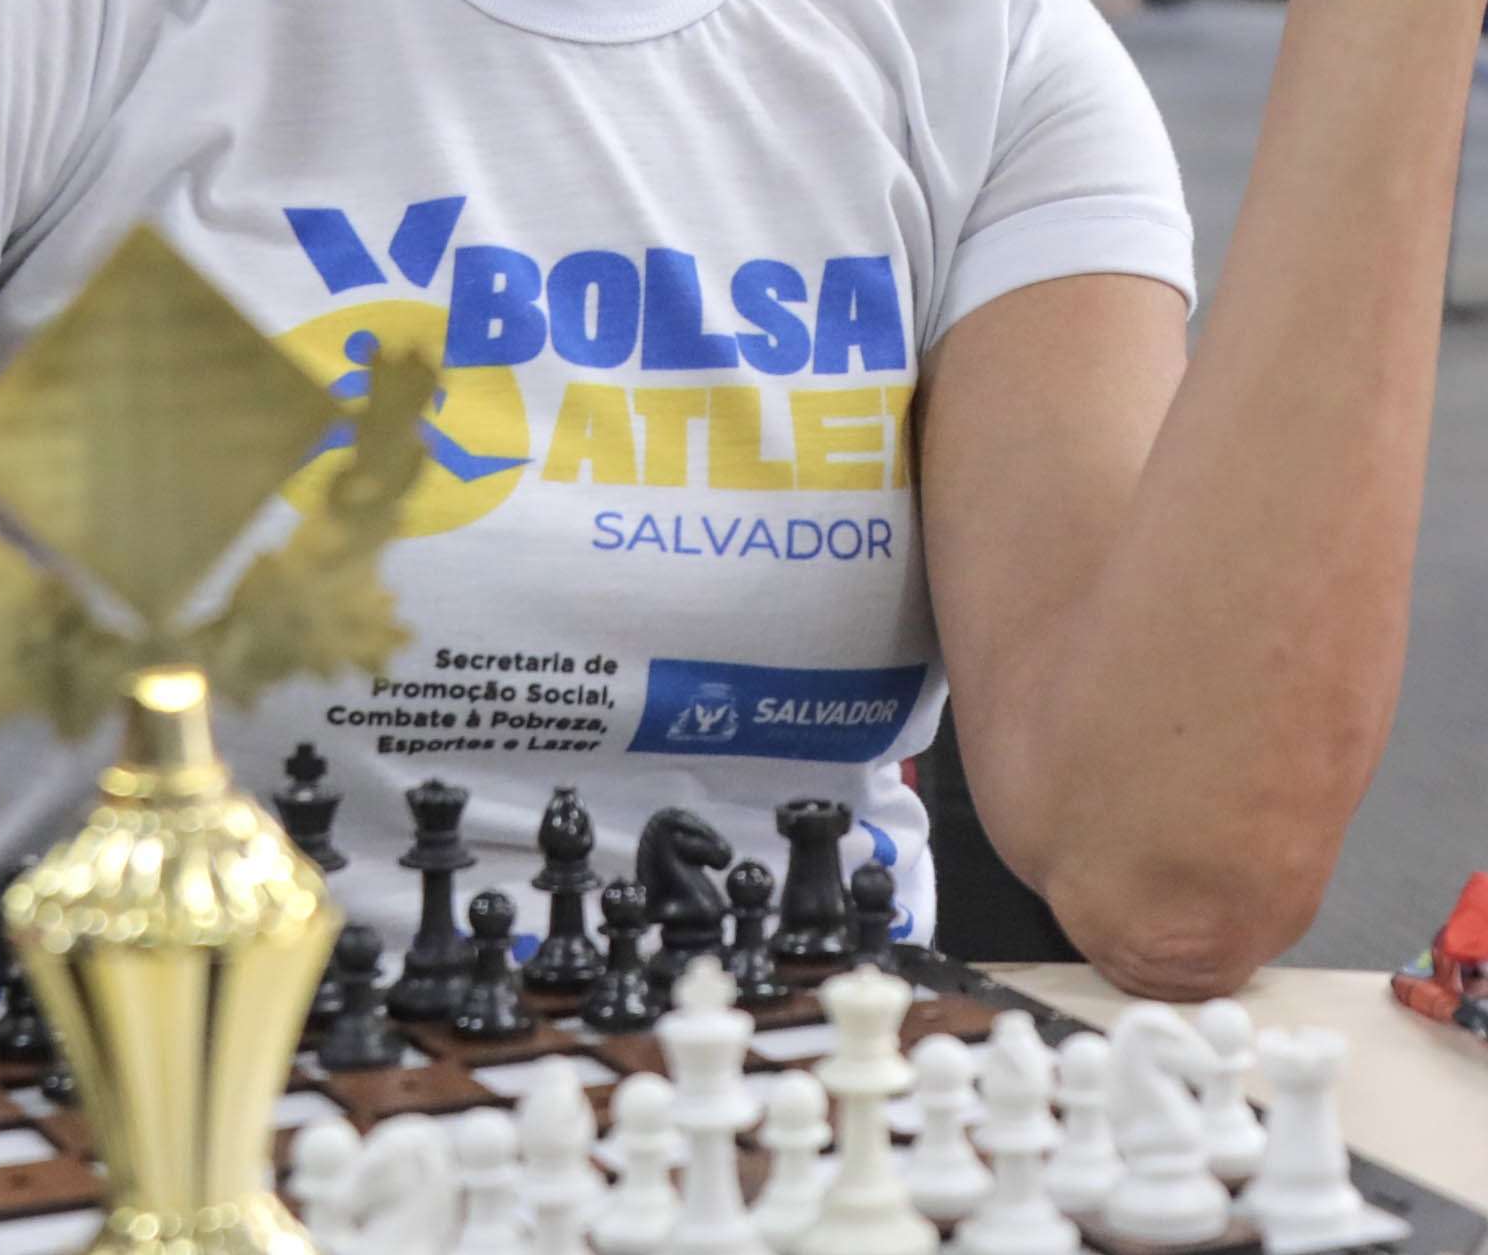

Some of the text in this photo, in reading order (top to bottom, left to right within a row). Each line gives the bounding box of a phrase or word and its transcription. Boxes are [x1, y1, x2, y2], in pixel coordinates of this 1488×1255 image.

[443, 245, 907, 375] BOLSA
[592, 512, 892, 560] SALVADOR
[435, 648, 618, 675] Secretaria de
[372, 677, 615, 709] Promoção Social,
[326, 705, 608, 734] Combate à Pobreza,
[752, 697, 899, 726] SALVADOR
[377, 735, 601, 755] Esportes e Lazer
